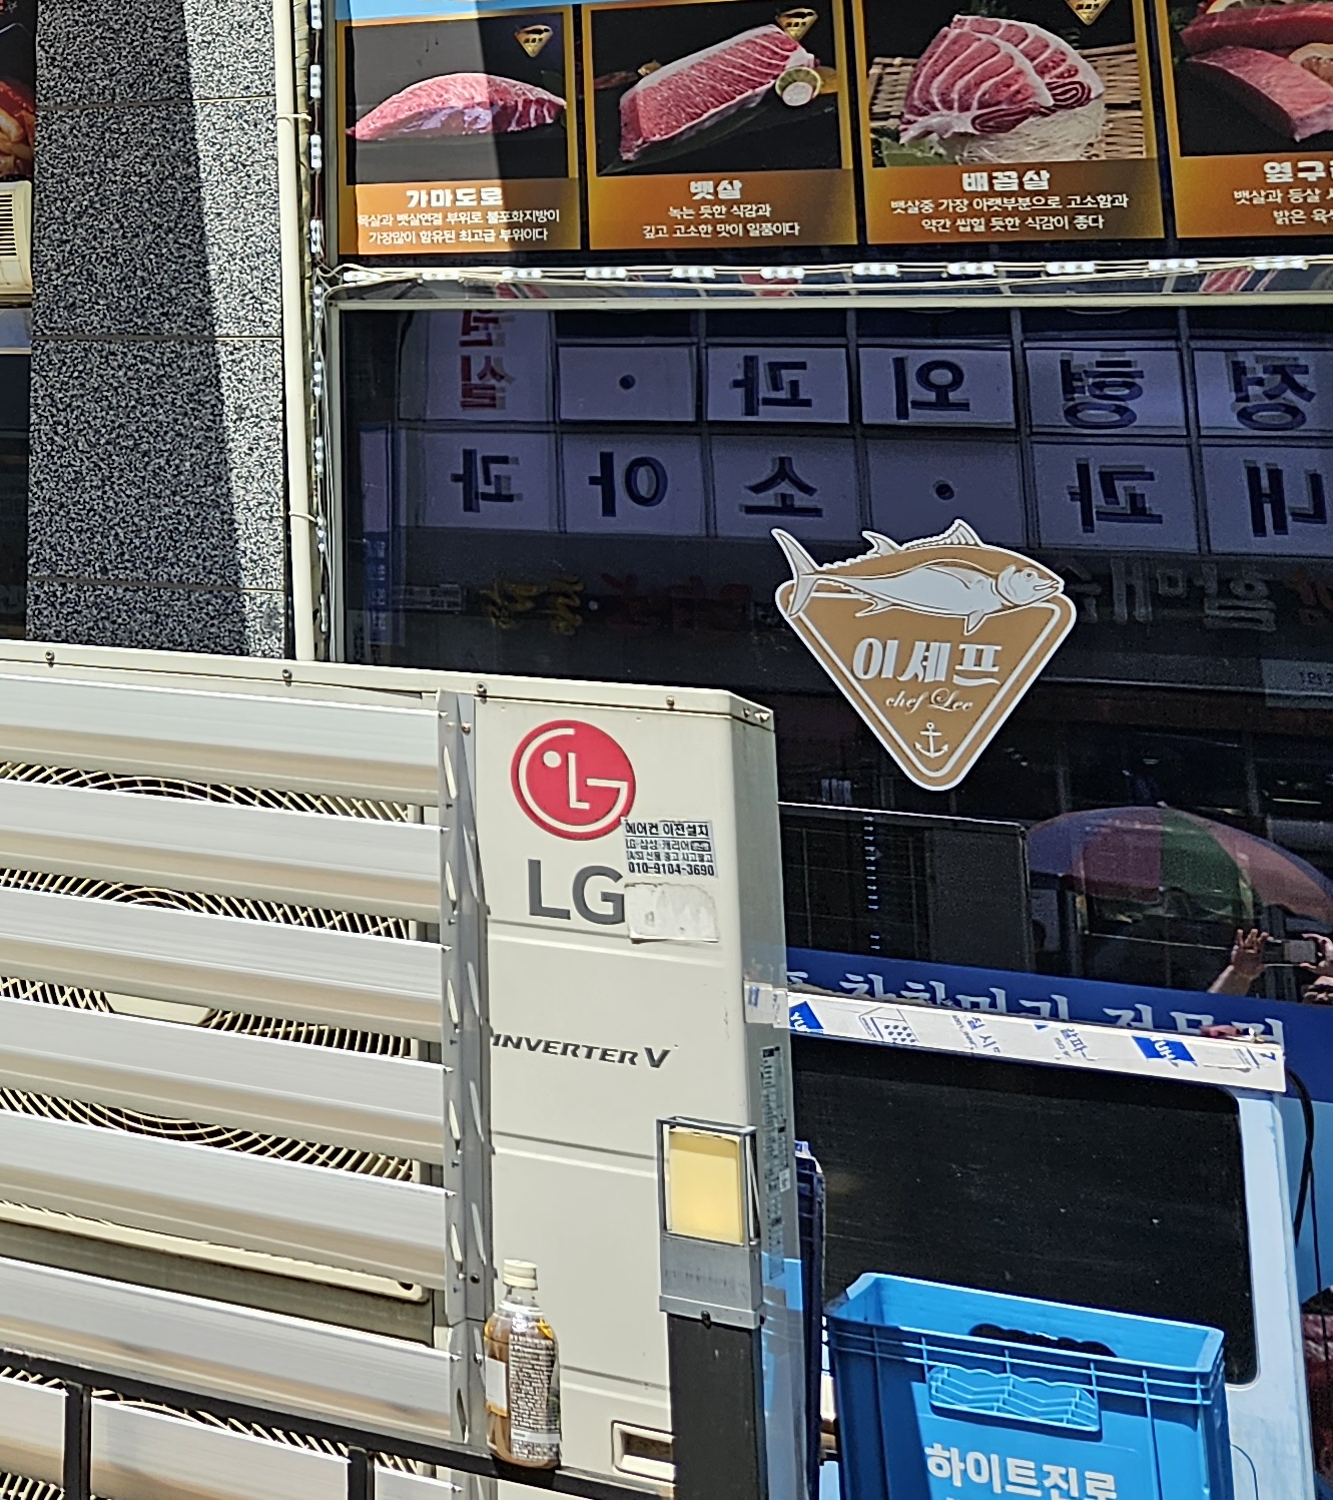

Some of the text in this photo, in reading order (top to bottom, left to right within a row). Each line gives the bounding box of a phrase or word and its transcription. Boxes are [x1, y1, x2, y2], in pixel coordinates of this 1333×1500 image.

[690, 179, 743, 200] 뱃살
[961, 170, 1052, 192] 배꼽살
[406, 186, 503, 207] 가마도로
[890, 193, 1129, 214] 뱃살중 가장 아랫부분으로 고소함과
[1233, 187, 1320, 205] 뱃살과 등살
[445, 210, 483, 226] 부위로
[485, 209, 561, 225] 불포화지방이
[699, 204, 727, 219] 듯한
[730, 203, 772, 218] 식감과
[1273, 207, 1305, 225] 밝은
[642, 221, 801, 239] 깊고 고소한 맛이 일품이다
[989, 215, 1021, 232] 듯한
[1026, 214, 1069, 231] 식감이
[1073, 213, 1104, 230] 좋다
[458, 228, 496, 244] 최고급
[499, 227, 548, 243] 부위이다
[852, 637, 1003, 687] 이셰프
[885, 687, 974, 715] chef Lee
[662, 822, 710, 837] 이전설치
[627, 862, 716, 877] 010-9104-3690
[527, 857, 626, 926] LG
[492, 1033, 673, 1070] INVERTER V
[923, 1442, 1119, 1500] 하이트진로
